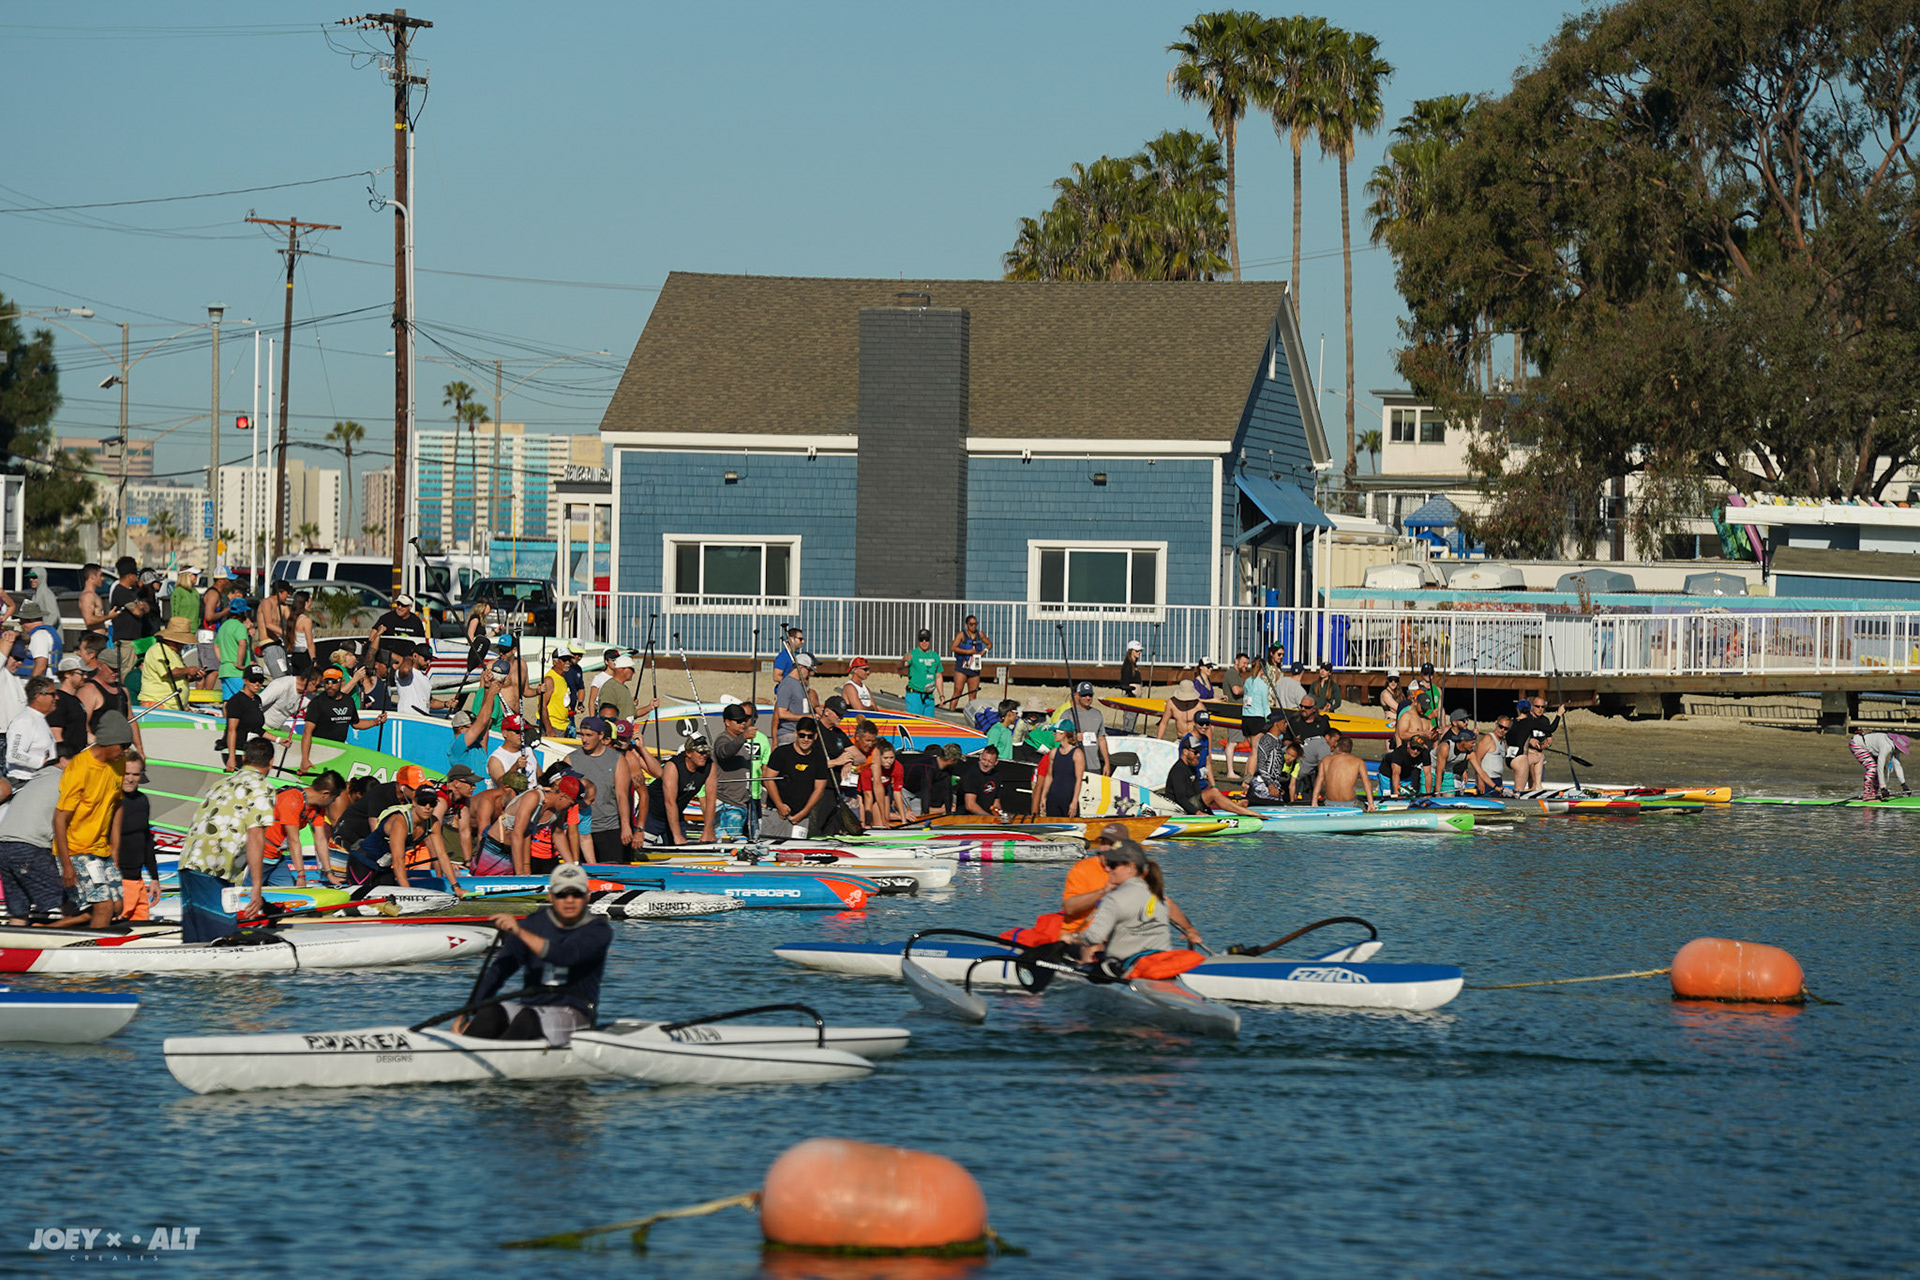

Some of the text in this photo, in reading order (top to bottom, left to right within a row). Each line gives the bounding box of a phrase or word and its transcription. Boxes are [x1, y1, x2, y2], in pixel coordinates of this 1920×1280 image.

[1380, 818, 1429, 828] RIVIERA
[724, 888, 802, 898] STARBOARD
[648, 902, 692, 911] INFINITY
[376, 1055, 413, 1064] DESIGNS
